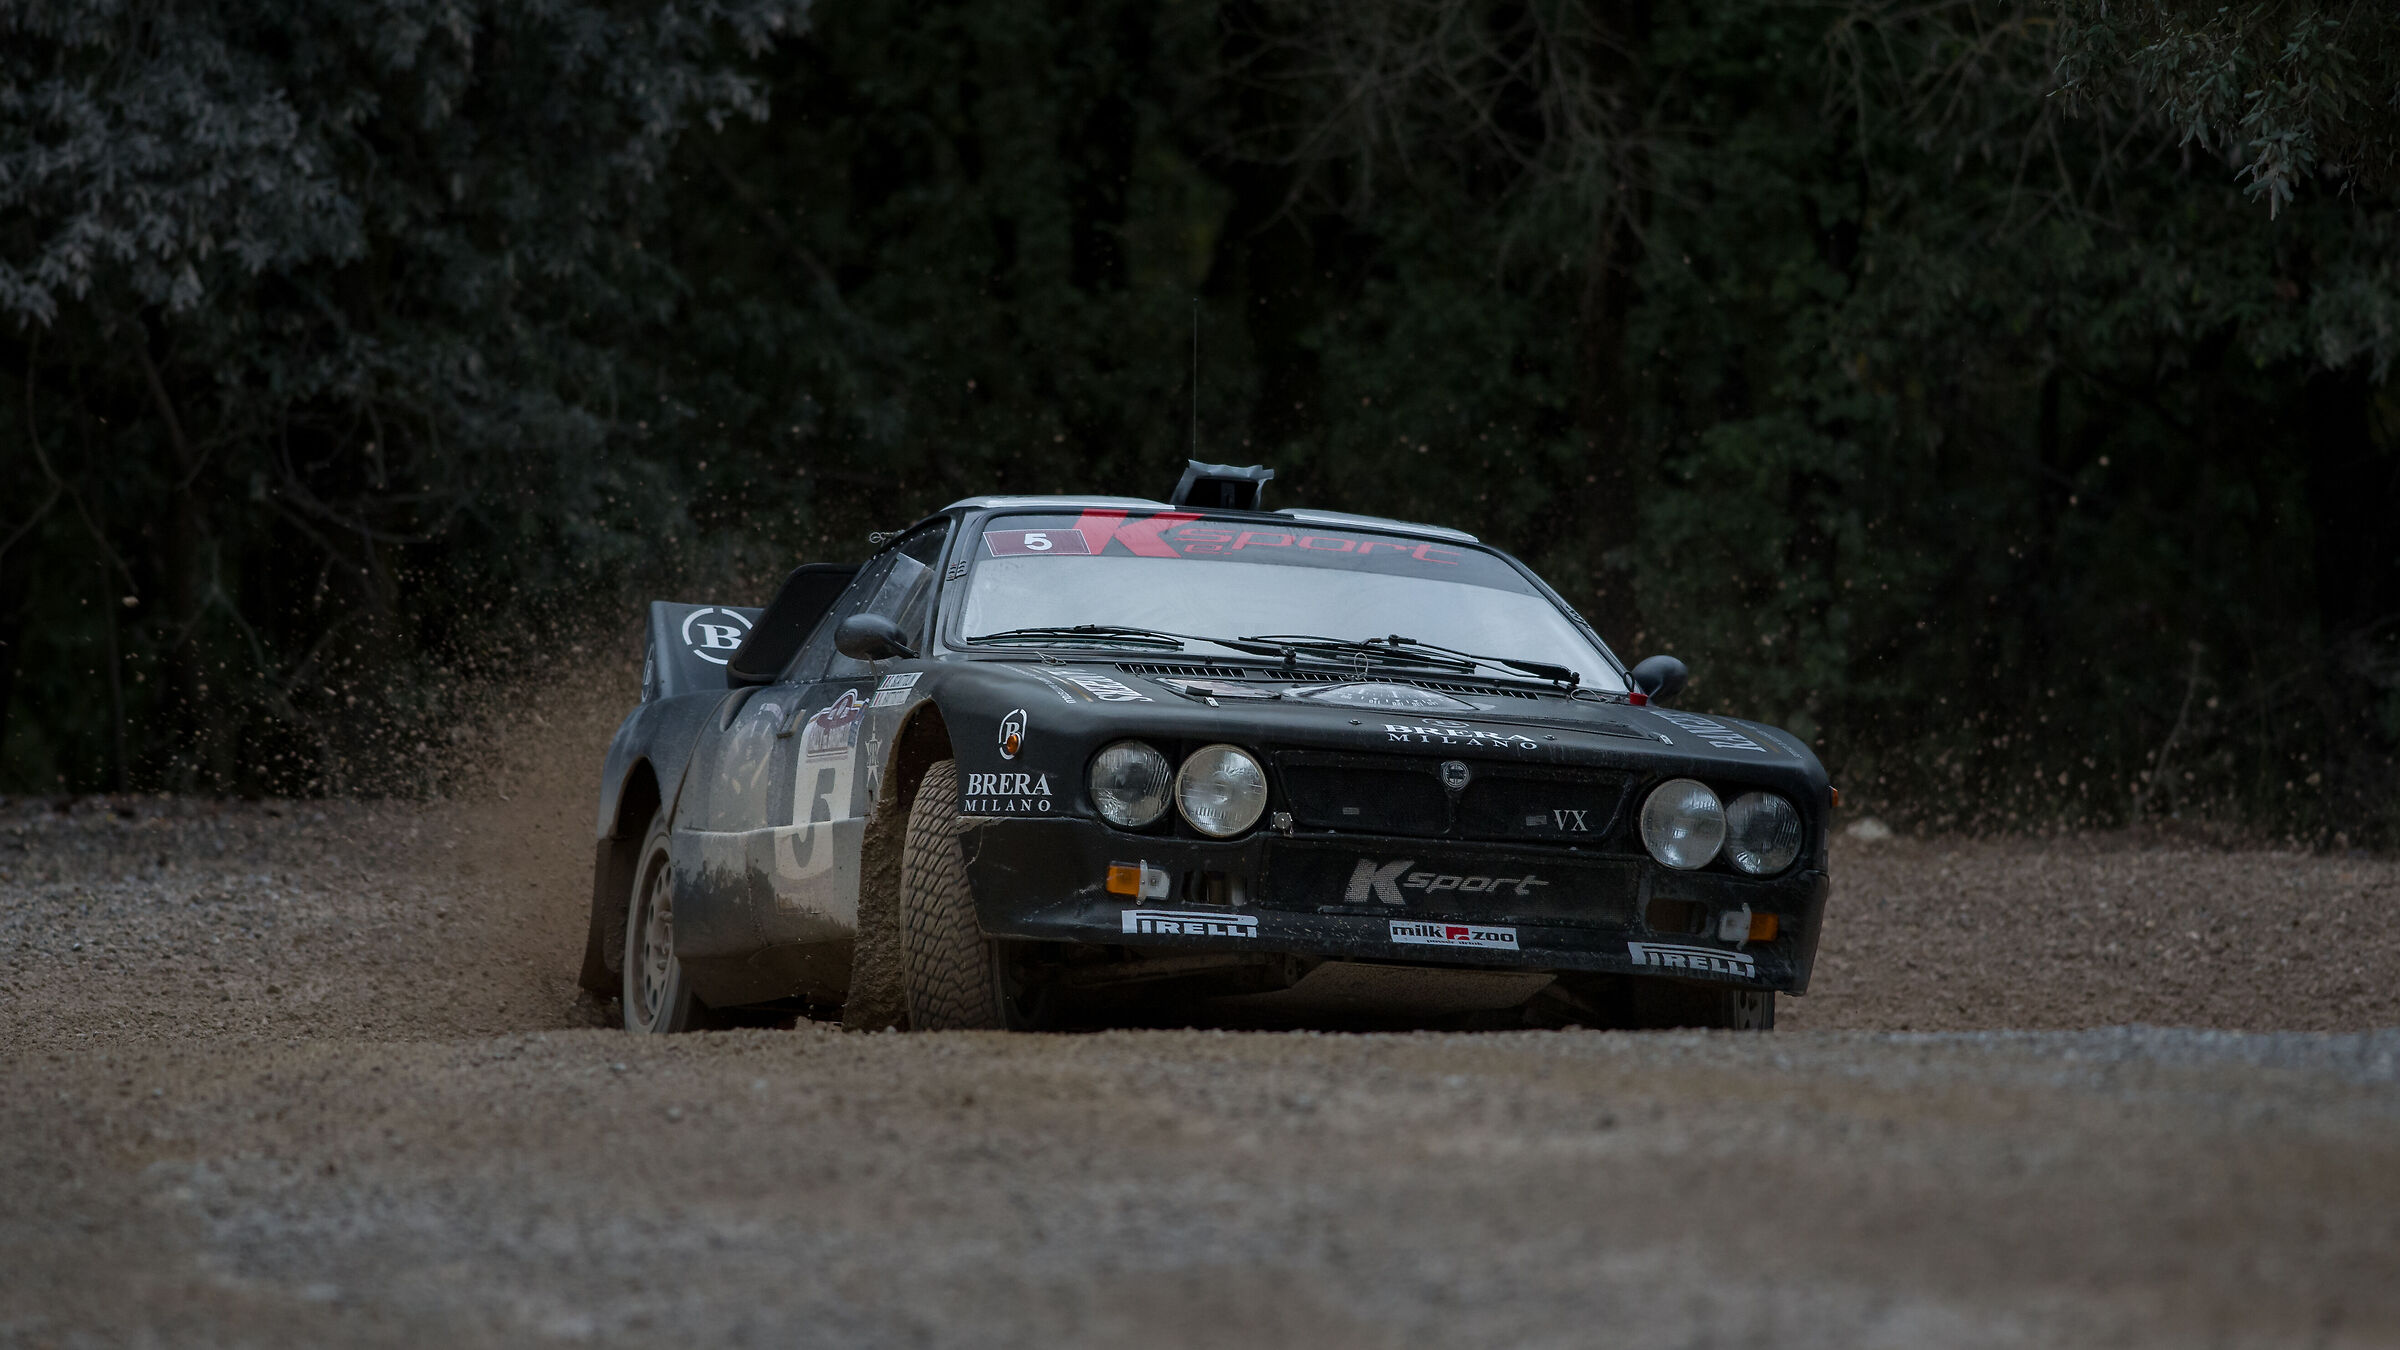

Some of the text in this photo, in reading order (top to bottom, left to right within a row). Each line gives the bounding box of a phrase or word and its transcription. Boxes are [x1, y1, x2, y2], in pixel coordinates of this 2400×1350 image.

[1024, 532, 1053, 551] 5
[697, 623, 743, 650] B
[1384, 723, 1536, 743] BRERA
[1387, 732, 1538, 750] MILANO
[965, 772, 1053, 796] BRERA
[963, 799, 1051, 812] MILANO
[1552, 809, 1589, 832] VX
[1121, 909, 1259, 939] PIRELLI
[1392, 924, 1515, 942] milk zoo
[1627, 941, 1757, 979] PIRELLI
